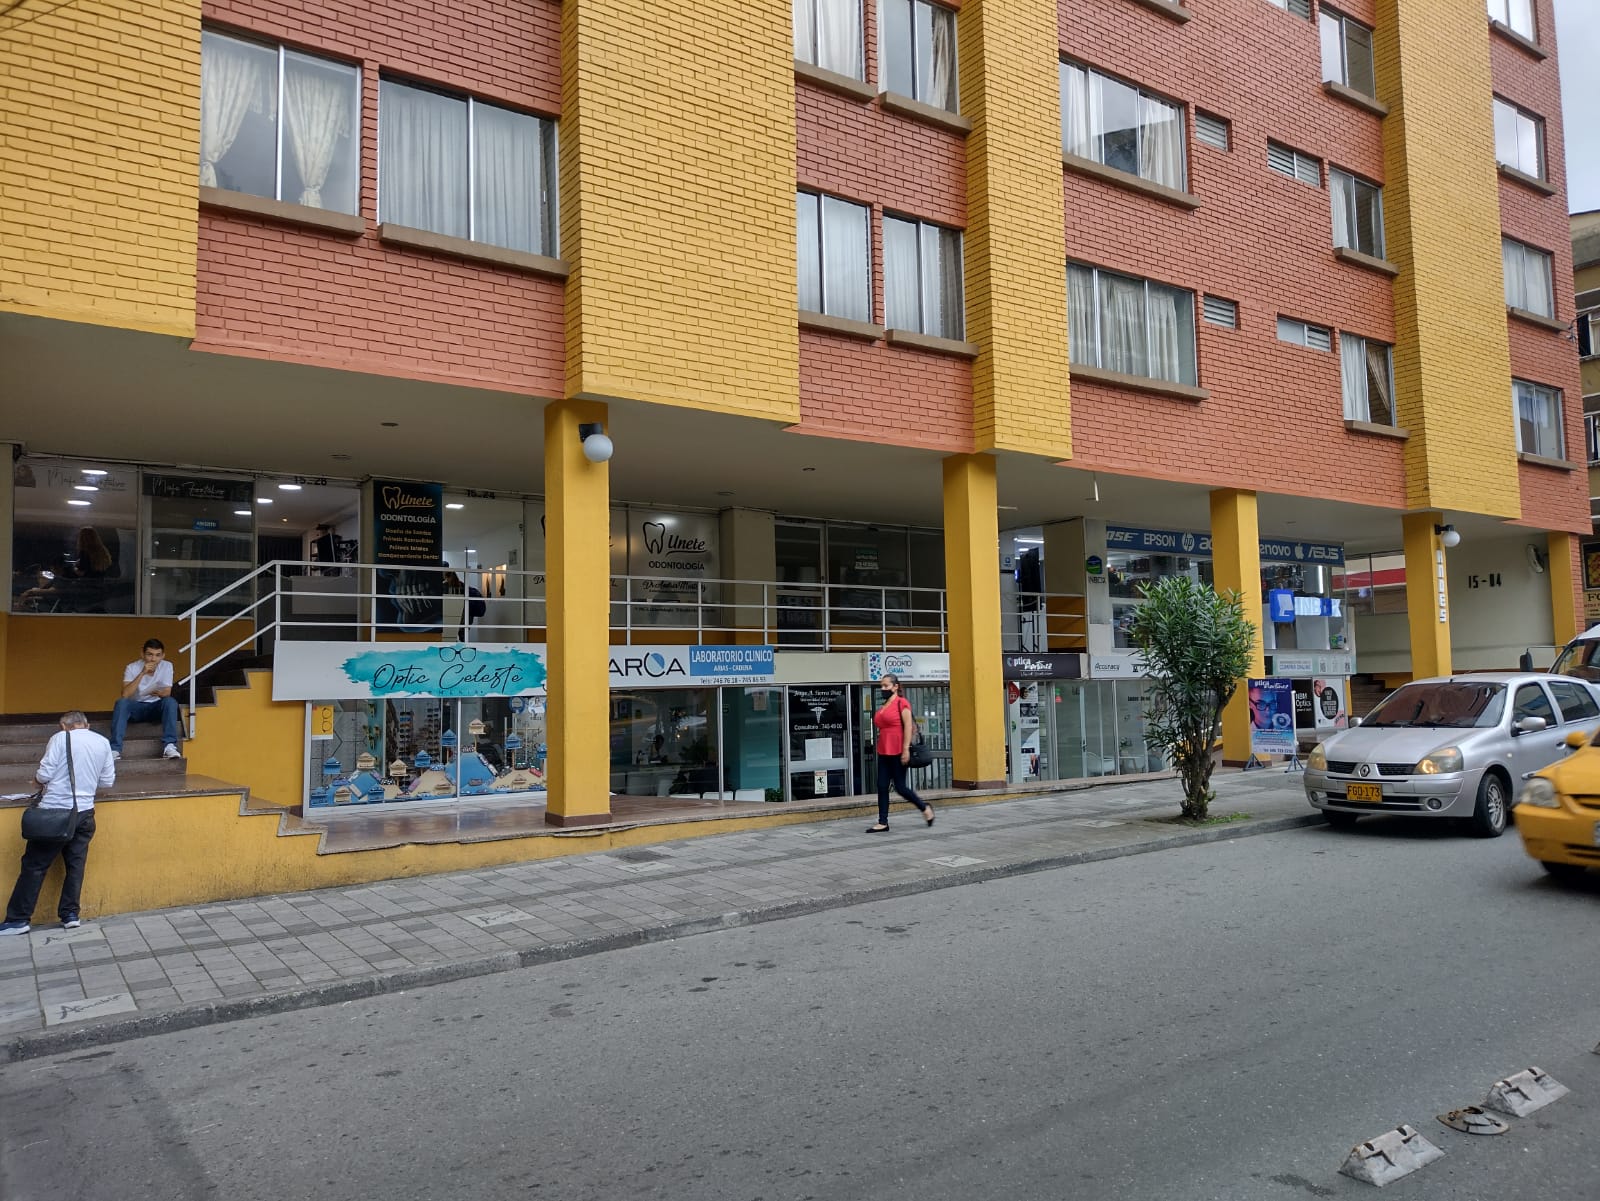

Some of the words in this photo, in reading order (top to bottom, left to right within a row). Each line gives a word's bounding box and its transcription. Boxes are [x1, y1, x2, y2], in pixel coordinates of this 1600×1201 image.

[380, 513, 436, 524] ODONTOLOGÍA
[668, 535, 706, 550] Unete
[1107, 531, 1139, 541] OSE
[1143, 533, 1175, 547] EPSON
[1259, 543, 1291, 557] enovo
[1308, 546, 1339, 560] ASUS
[649, 560, 705, 571] ODONTOLOGÍA
[691, 651, 743, 663] LABORATORIO
[744, 650, 773, 662] CLINICO
[1095, 662, 1120, 671] Accuracy
[373, 664, 430, 690] Optic
[439, 664, 524, 694] Celeste
[1295, 700, 1312, 708] Optics
